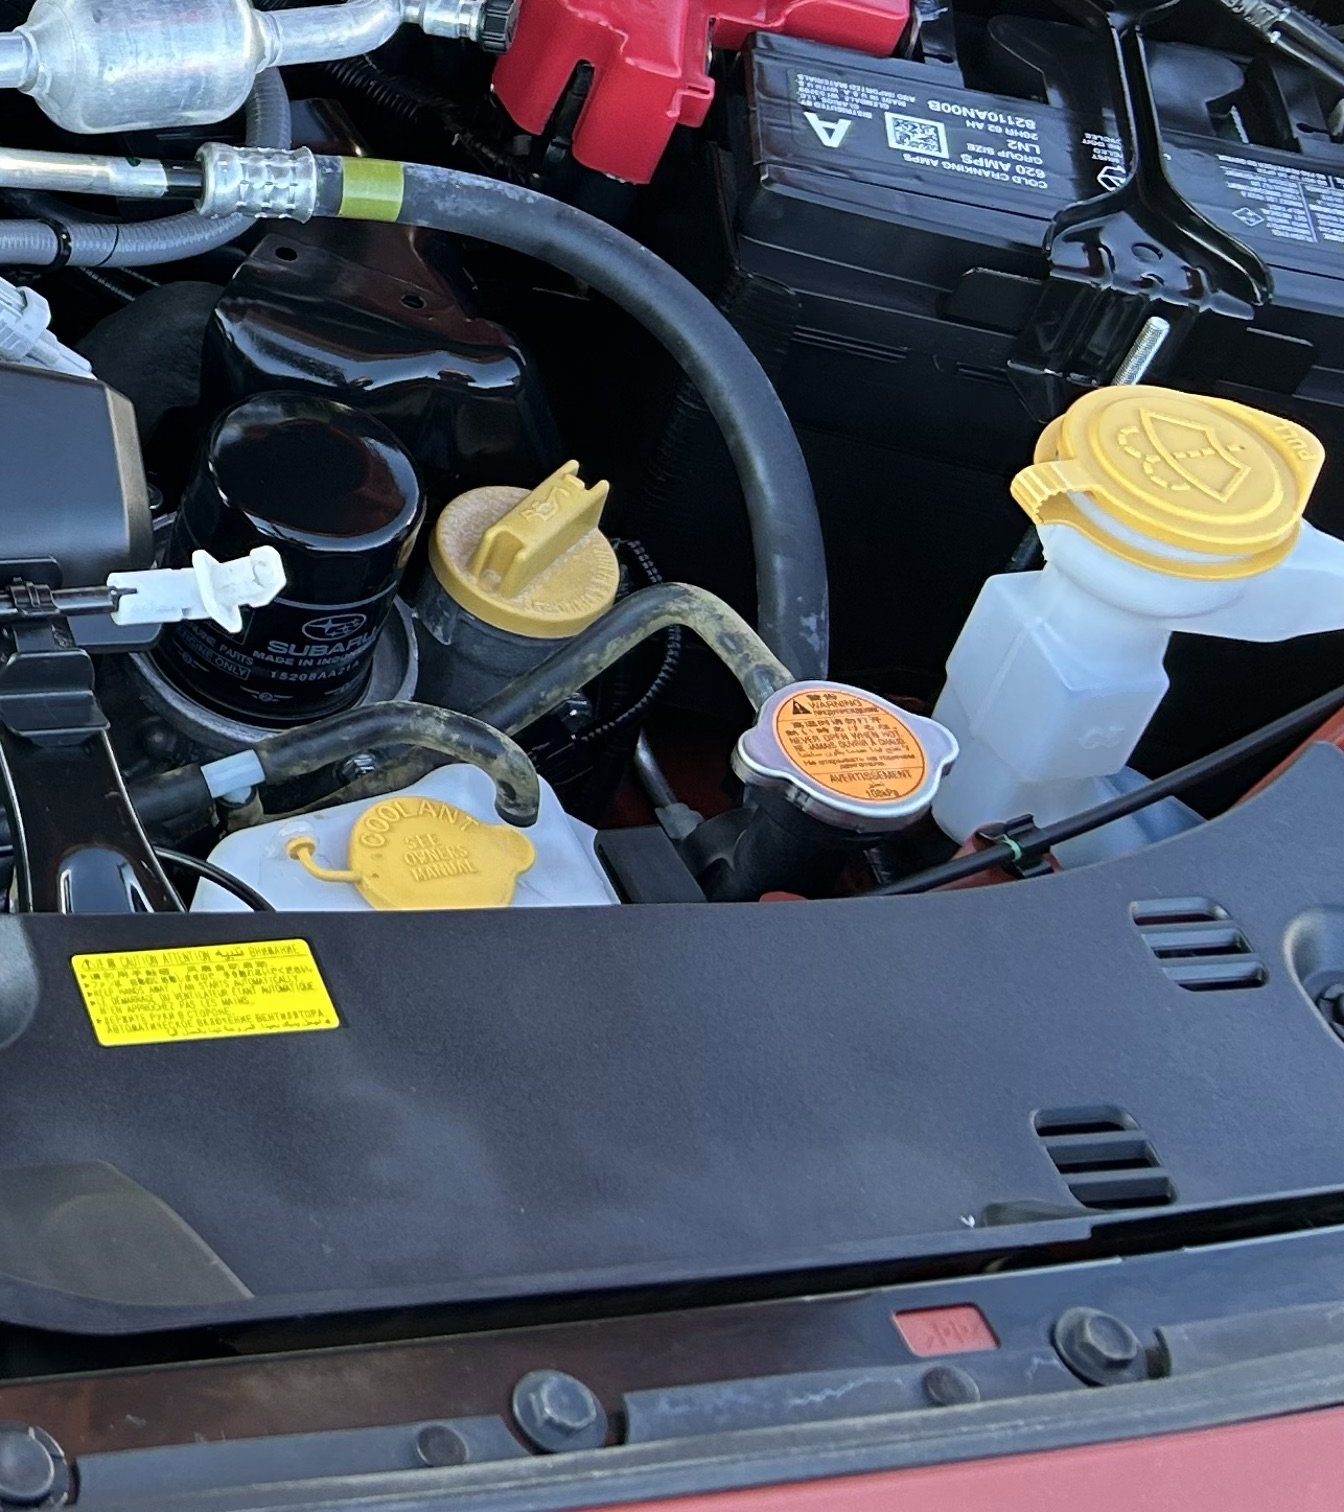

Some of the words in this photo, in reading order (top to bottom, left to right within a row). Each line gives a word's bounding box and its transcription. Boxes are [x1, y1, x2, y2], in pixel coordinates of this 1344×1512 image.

[813, 101, 873, 120] DISTRIBUTED
[881, 96, 907, 108] MADE
[966, 142, 995, 156] SIZE
[1006, 138, 1041, 155] LN2
[902, 152, 939, 167] AMPS
[960, 153, 1011, 172] AMPS
[997, 149, 1043, 165] GROUP
[941, 161, 1010, 181] CRANKING
[1015, 164, 1046, 179] 620
[1011, 175, 1048, 189] COLD
[268, 626, 377, 657] SUBARU
[219, 644, 254, 666] PARTS
[253, 650, 294, 666] MADE
[298, 658, 314, 666] IN
[215, 657, 247, 676] ONLY
[808, 699, 863, 708] WARNING
[788, 735, 820, 745] NEVER
[825, 733, 849, 742] OPEN
[852, 731, 879, 741] WHEN
[830, 769, 913, 784] AVERTISSEMENT
[360, 799, 480, 848] COOLANT
[405, 833, 441, 850] SEE
[403, 844, 469, 866] OWNERS
[411, 858, 479, 882] MANUAL
[120, 954, 159, 968] CAUTION
[162, 950, 210, 964] ATTENTION
[198, 979, 230, 990] STARTS
